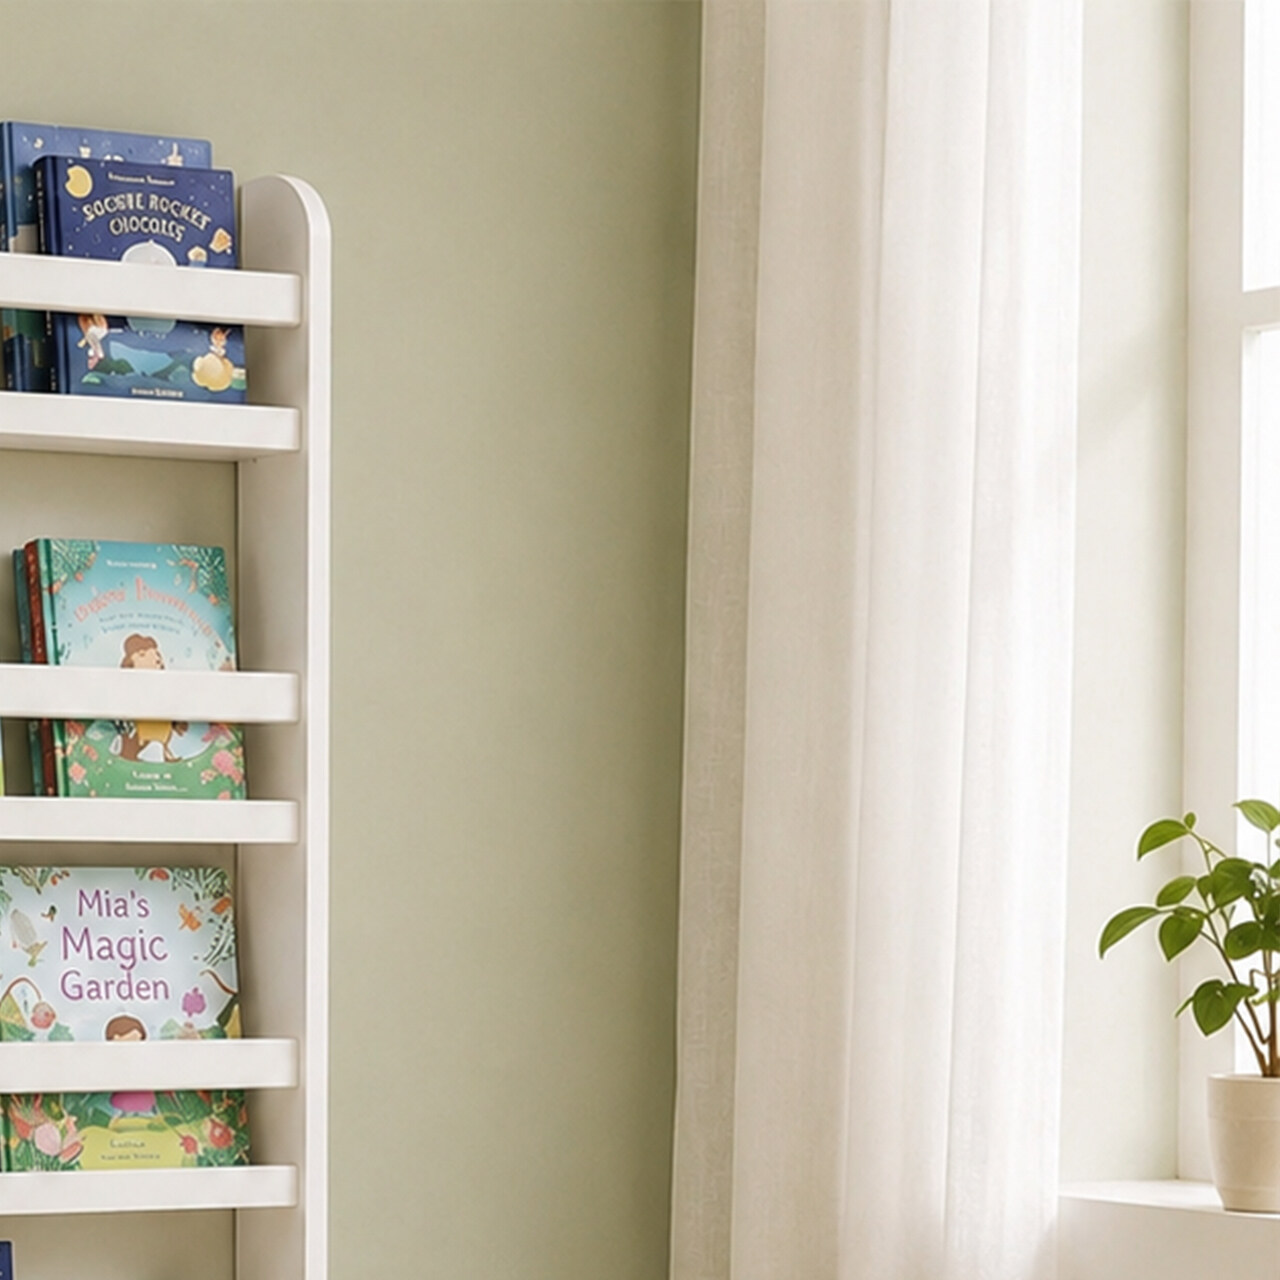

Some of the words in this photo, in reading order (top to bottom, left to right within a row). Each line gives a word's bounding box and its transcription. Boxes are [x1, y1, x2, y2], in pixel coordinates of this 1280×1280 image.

[78, 889, 150, 918] Mia's
[62, 926, 169, 971] Magic
[60, 970, 170, 1001] Garden
